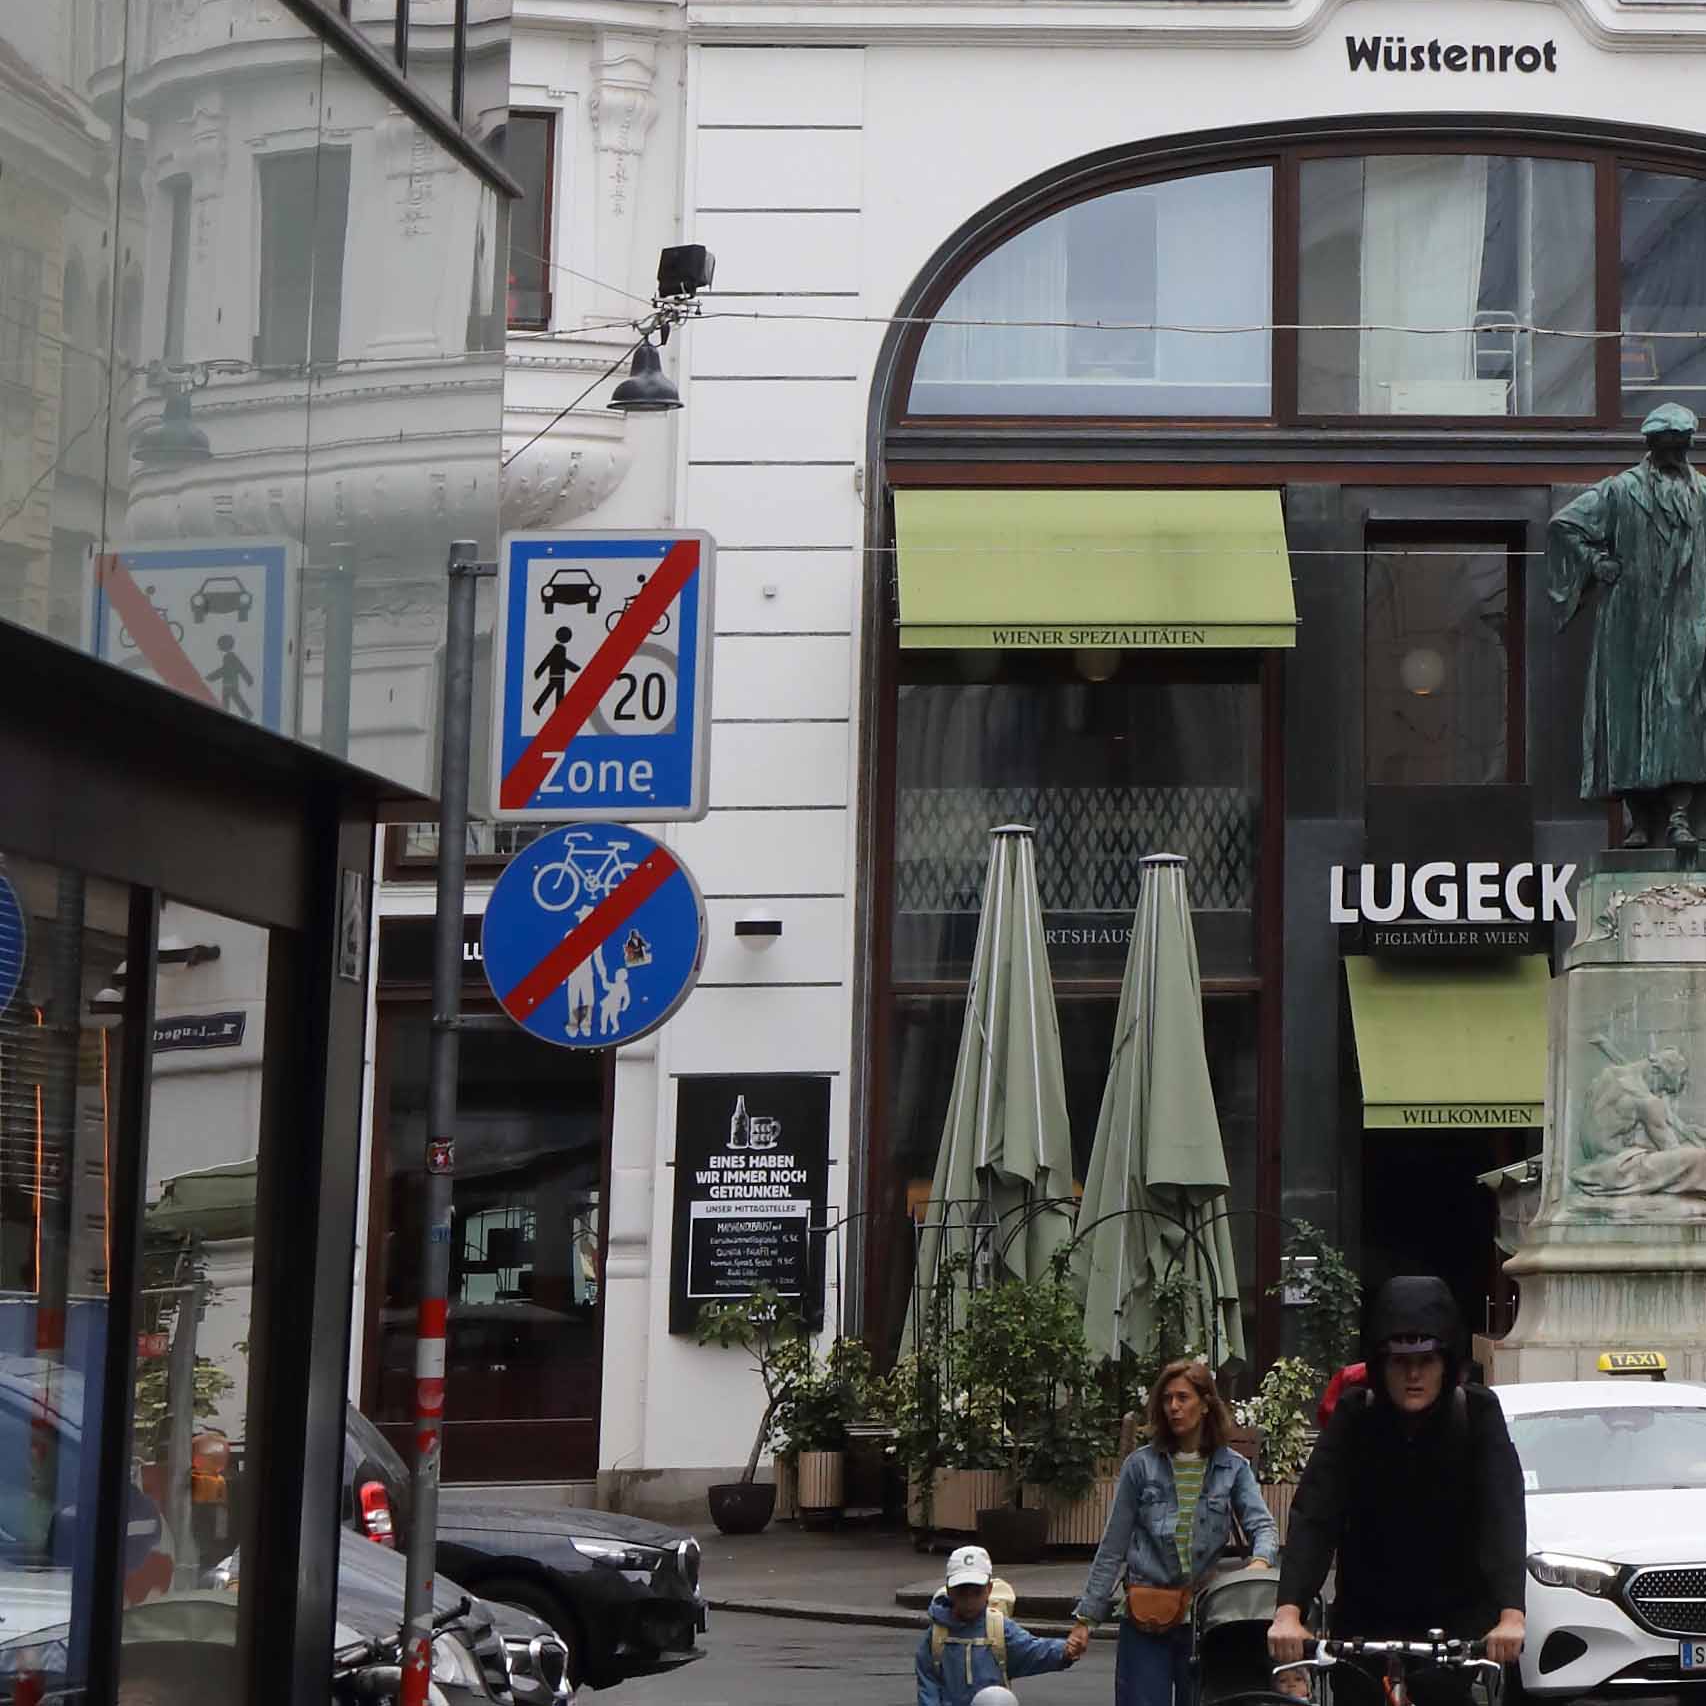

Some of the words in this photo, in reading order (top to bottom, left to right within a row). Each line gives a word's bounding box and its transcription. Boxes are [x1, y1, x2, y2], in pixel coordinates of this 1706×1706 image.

[1345, 36, 1557, 73] Wüstenrot
[993, 630, 1064, 645] WIENER
[1069, 627, 1205, 645] SPEZIALITÄTEN
[613, 672, 667, 721] 20
[539, 750, 653, 793] Zone
[1330, 862, 1577, 923] LUGECK
[1375, 928, 1479, 946] FIGLMÜLLER
[1480, 931, 1530, 944] WIEN
[1402, 1108, 1533, 1124] WILLKOMMEN
[709, 1155, 746, 1169] EINES
[749, 1155, 794, 1169] HABEN
[696, 1171, 720, 1184] WIR
[723, 1170, 768, 1184] IMMER
[770, 1170, 807, 1184] NOCH
[709, 1185, 792, 1199] GETRUNKEN.
[705, 1205, 732, 1214] UNSER
[1611, 1353, 1657, 1365] TAXI
